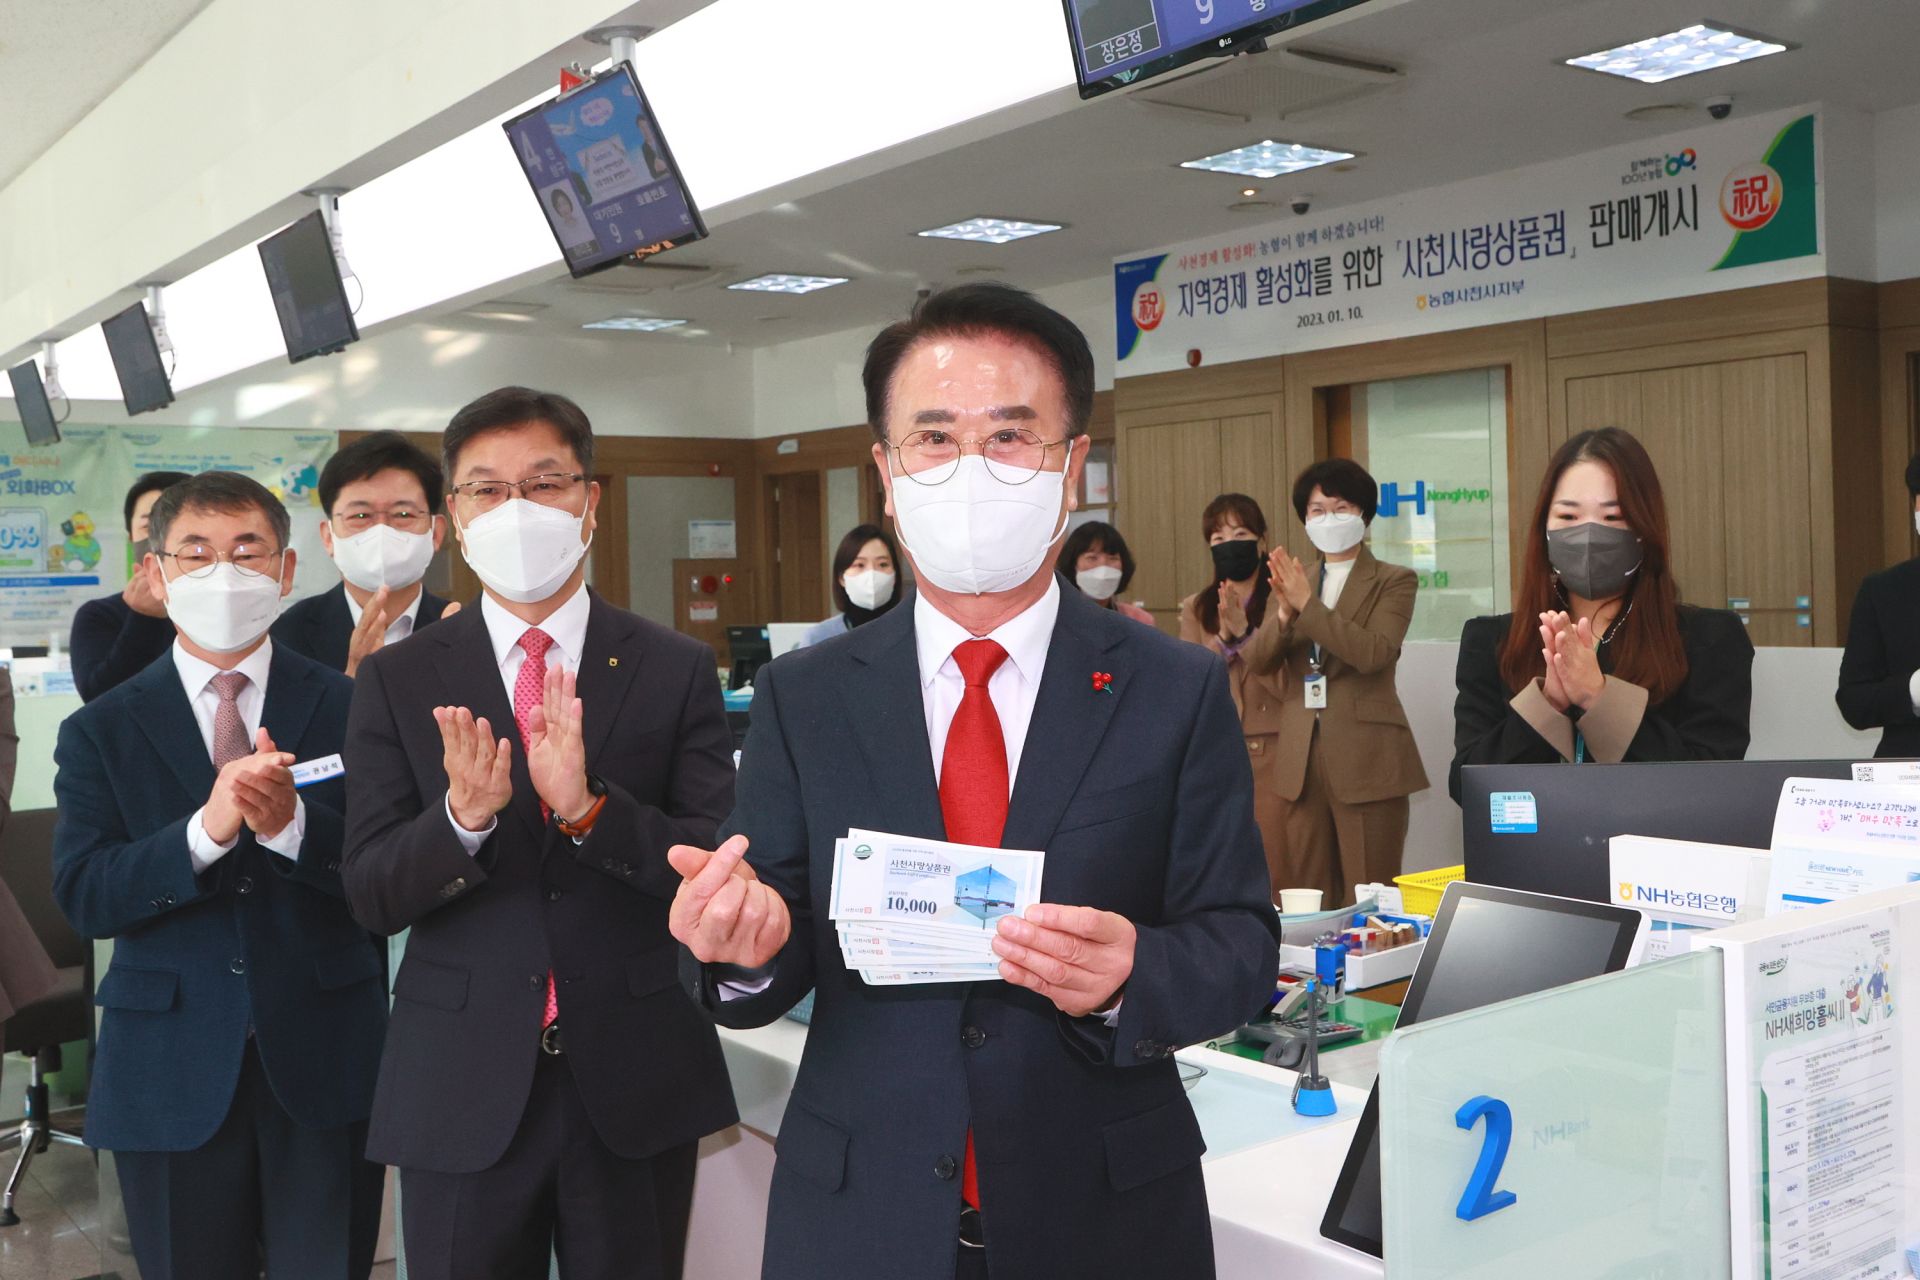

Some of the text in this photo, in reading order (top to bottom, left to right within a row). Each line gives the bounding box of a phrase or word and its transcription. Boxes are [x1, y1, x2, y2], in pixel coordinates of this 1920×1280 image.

[1100, 29, 1143, 64] 장은정
[520, 130, 543, 173] 4
[1732, 174, 1771, 217] 祝
[609, 222, 622, 244] 9
[1258, 236, 1292, 256] 농협이
[1295, 229, 1318, 248] 함께
[1321, 215, 1385, 242] 하겠습니다!
[1177, 271, 1248, 318] 지역경제
[1256, 256, 1333, 307] 활성화를
[1342, 245, 1384, 291] 위한
[1589, 184, 1699, 249] 판매개시
[1139, 292, 1158, 321] 祝
[1428, 279, 1525, 309] 농협사천시지부
[1296, 305, 1364, 329] 2023. 01. 10.
[1427, 488, 1490, 503] NongHyup
[890, 858, 951, 874] 사천사랑상품권
[887, 896, 937, 917] 10,000
[1637, 885, 1737, 914] NH농협은행
[1455, 1095, 1517, 1222] 2
